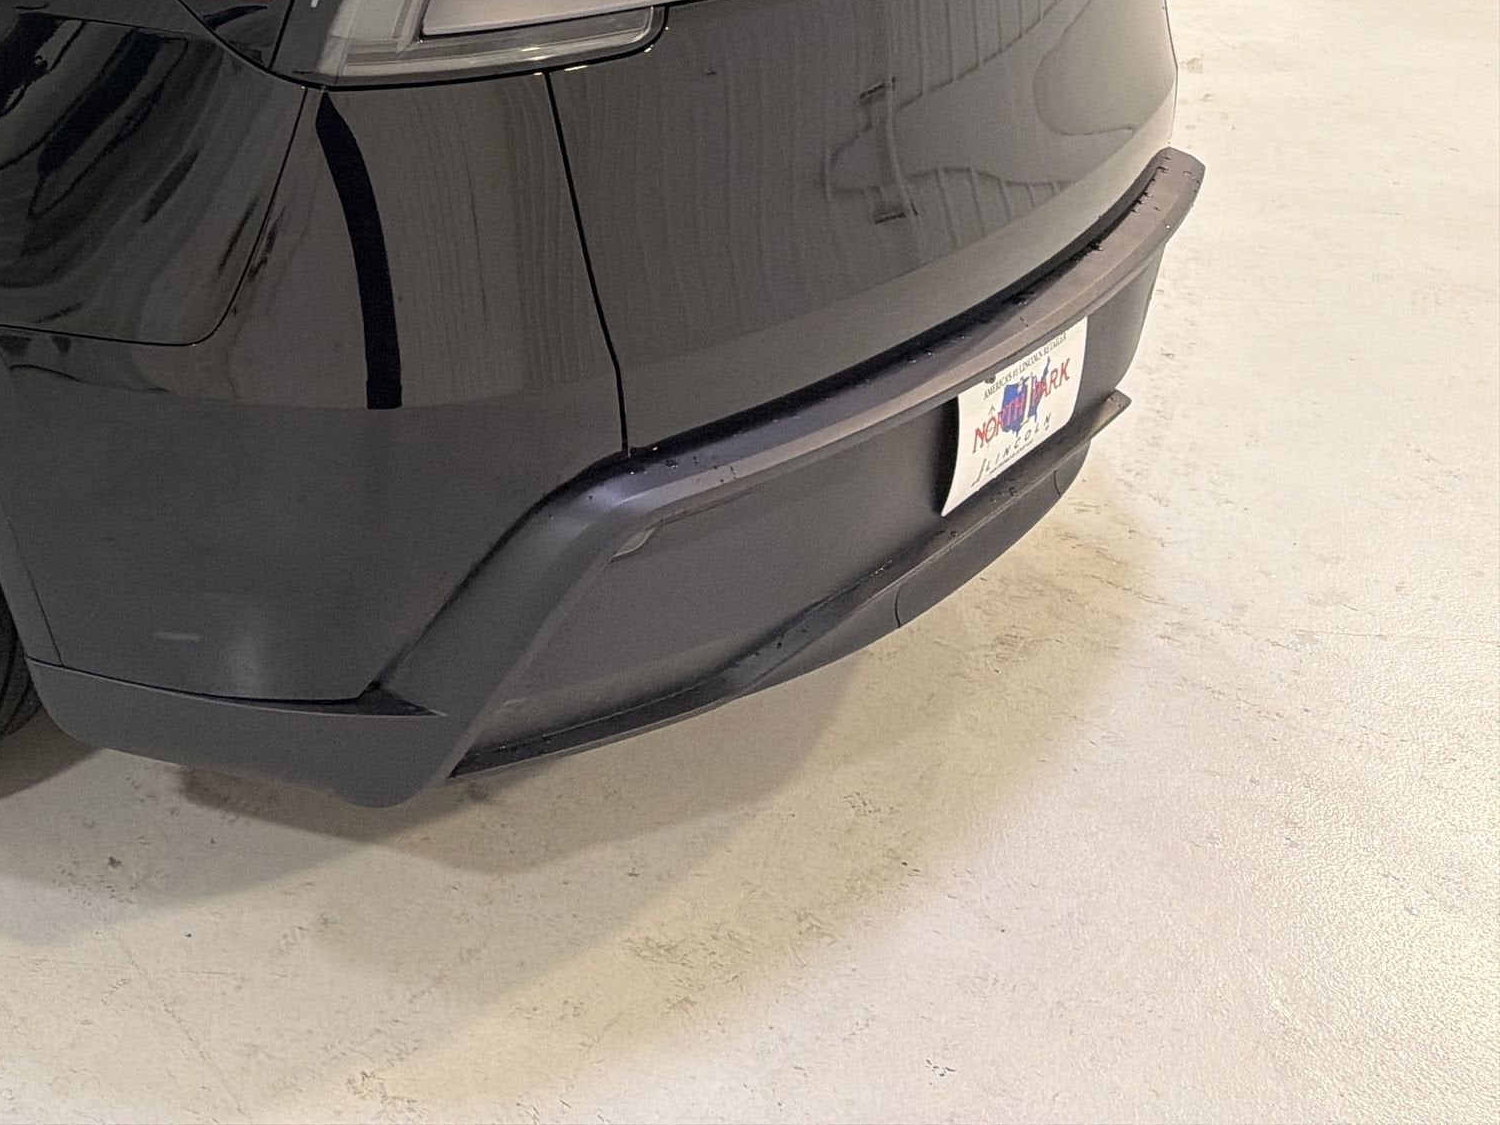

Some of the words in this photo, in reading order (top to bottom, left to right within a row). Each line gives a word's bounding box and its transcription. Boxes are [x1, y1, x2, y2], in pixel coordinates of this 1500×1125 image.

[984, 374, 1013, 400] AMERICA'S
[1019, 349, 1043, 374] LINCOLN
[1043, 332, 1068, 356] RETAILER
[972, 394, 1026, 454] NORTH
[1031, 357, 1071, 404] PARK
[980, 413, 1052, 477] LINCOLN
